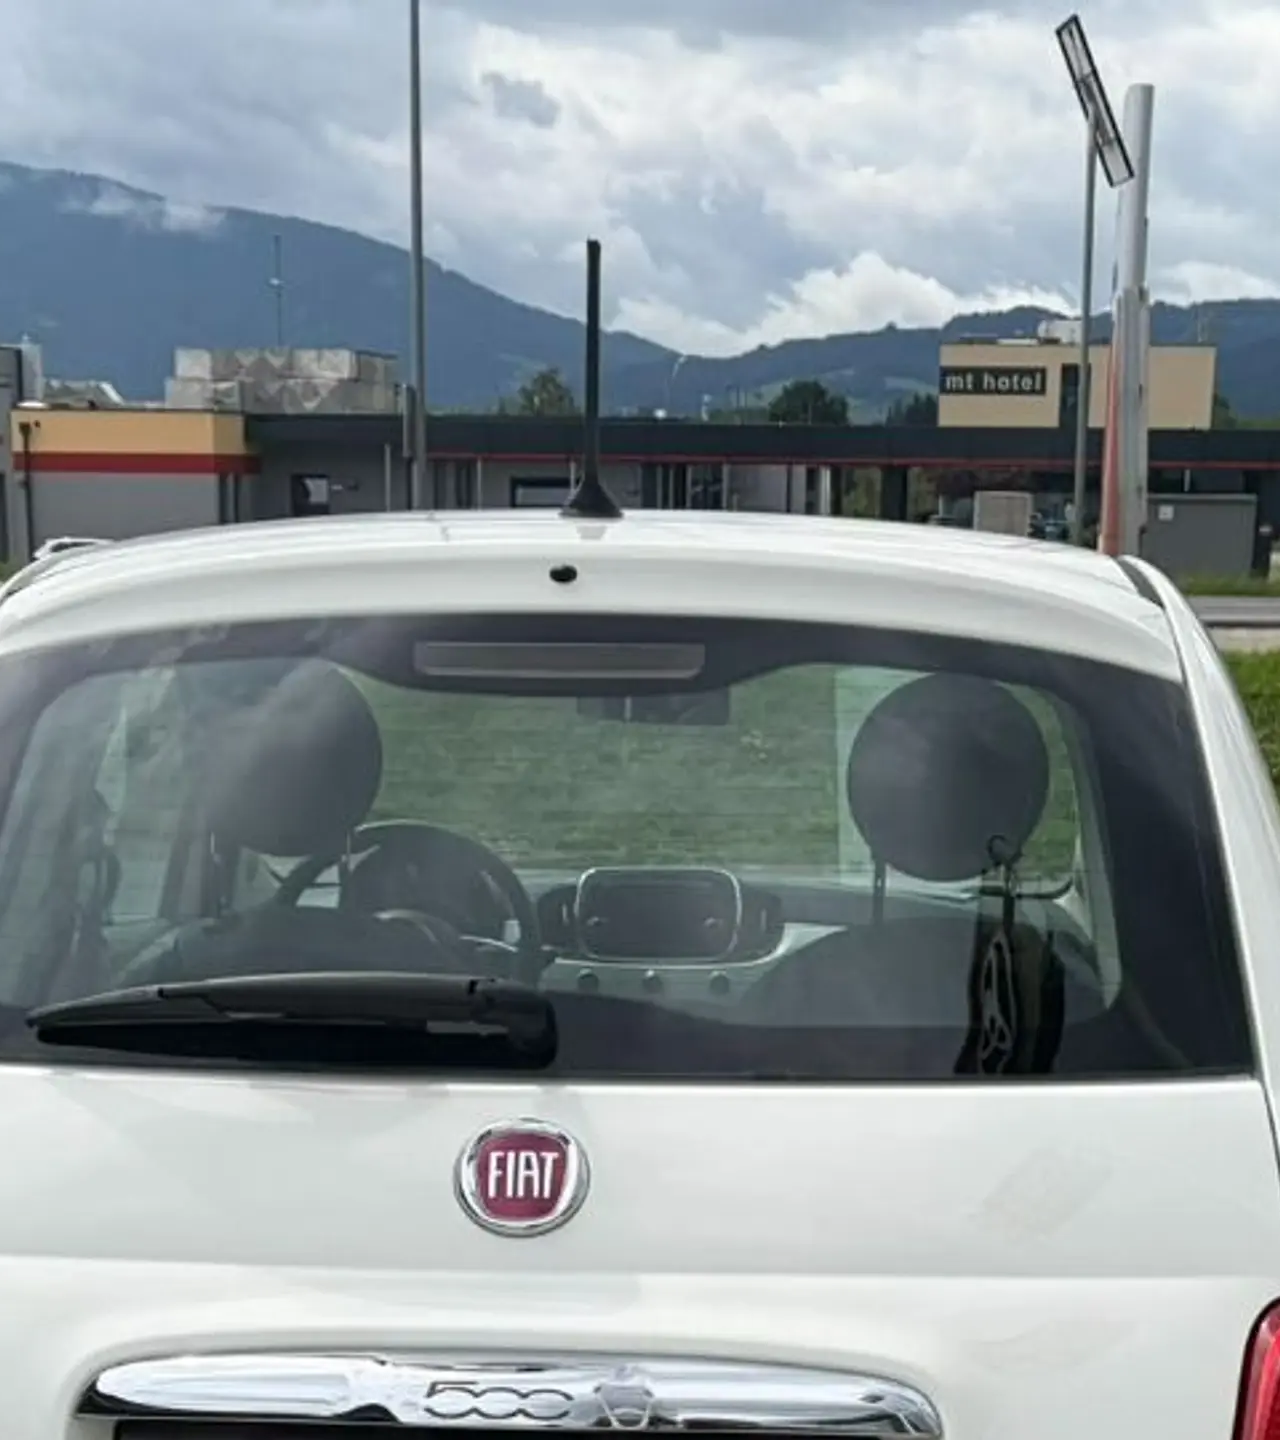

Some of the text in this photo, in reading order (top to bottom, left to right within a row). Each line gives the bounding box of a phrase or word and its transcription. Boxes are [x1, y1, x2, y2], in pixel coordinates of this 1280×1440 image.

[945, 371, 1042, 391] mt hotel
[488, 1151, 559, 1199] FIAT
[424, 1381, 574, 1420] 500
